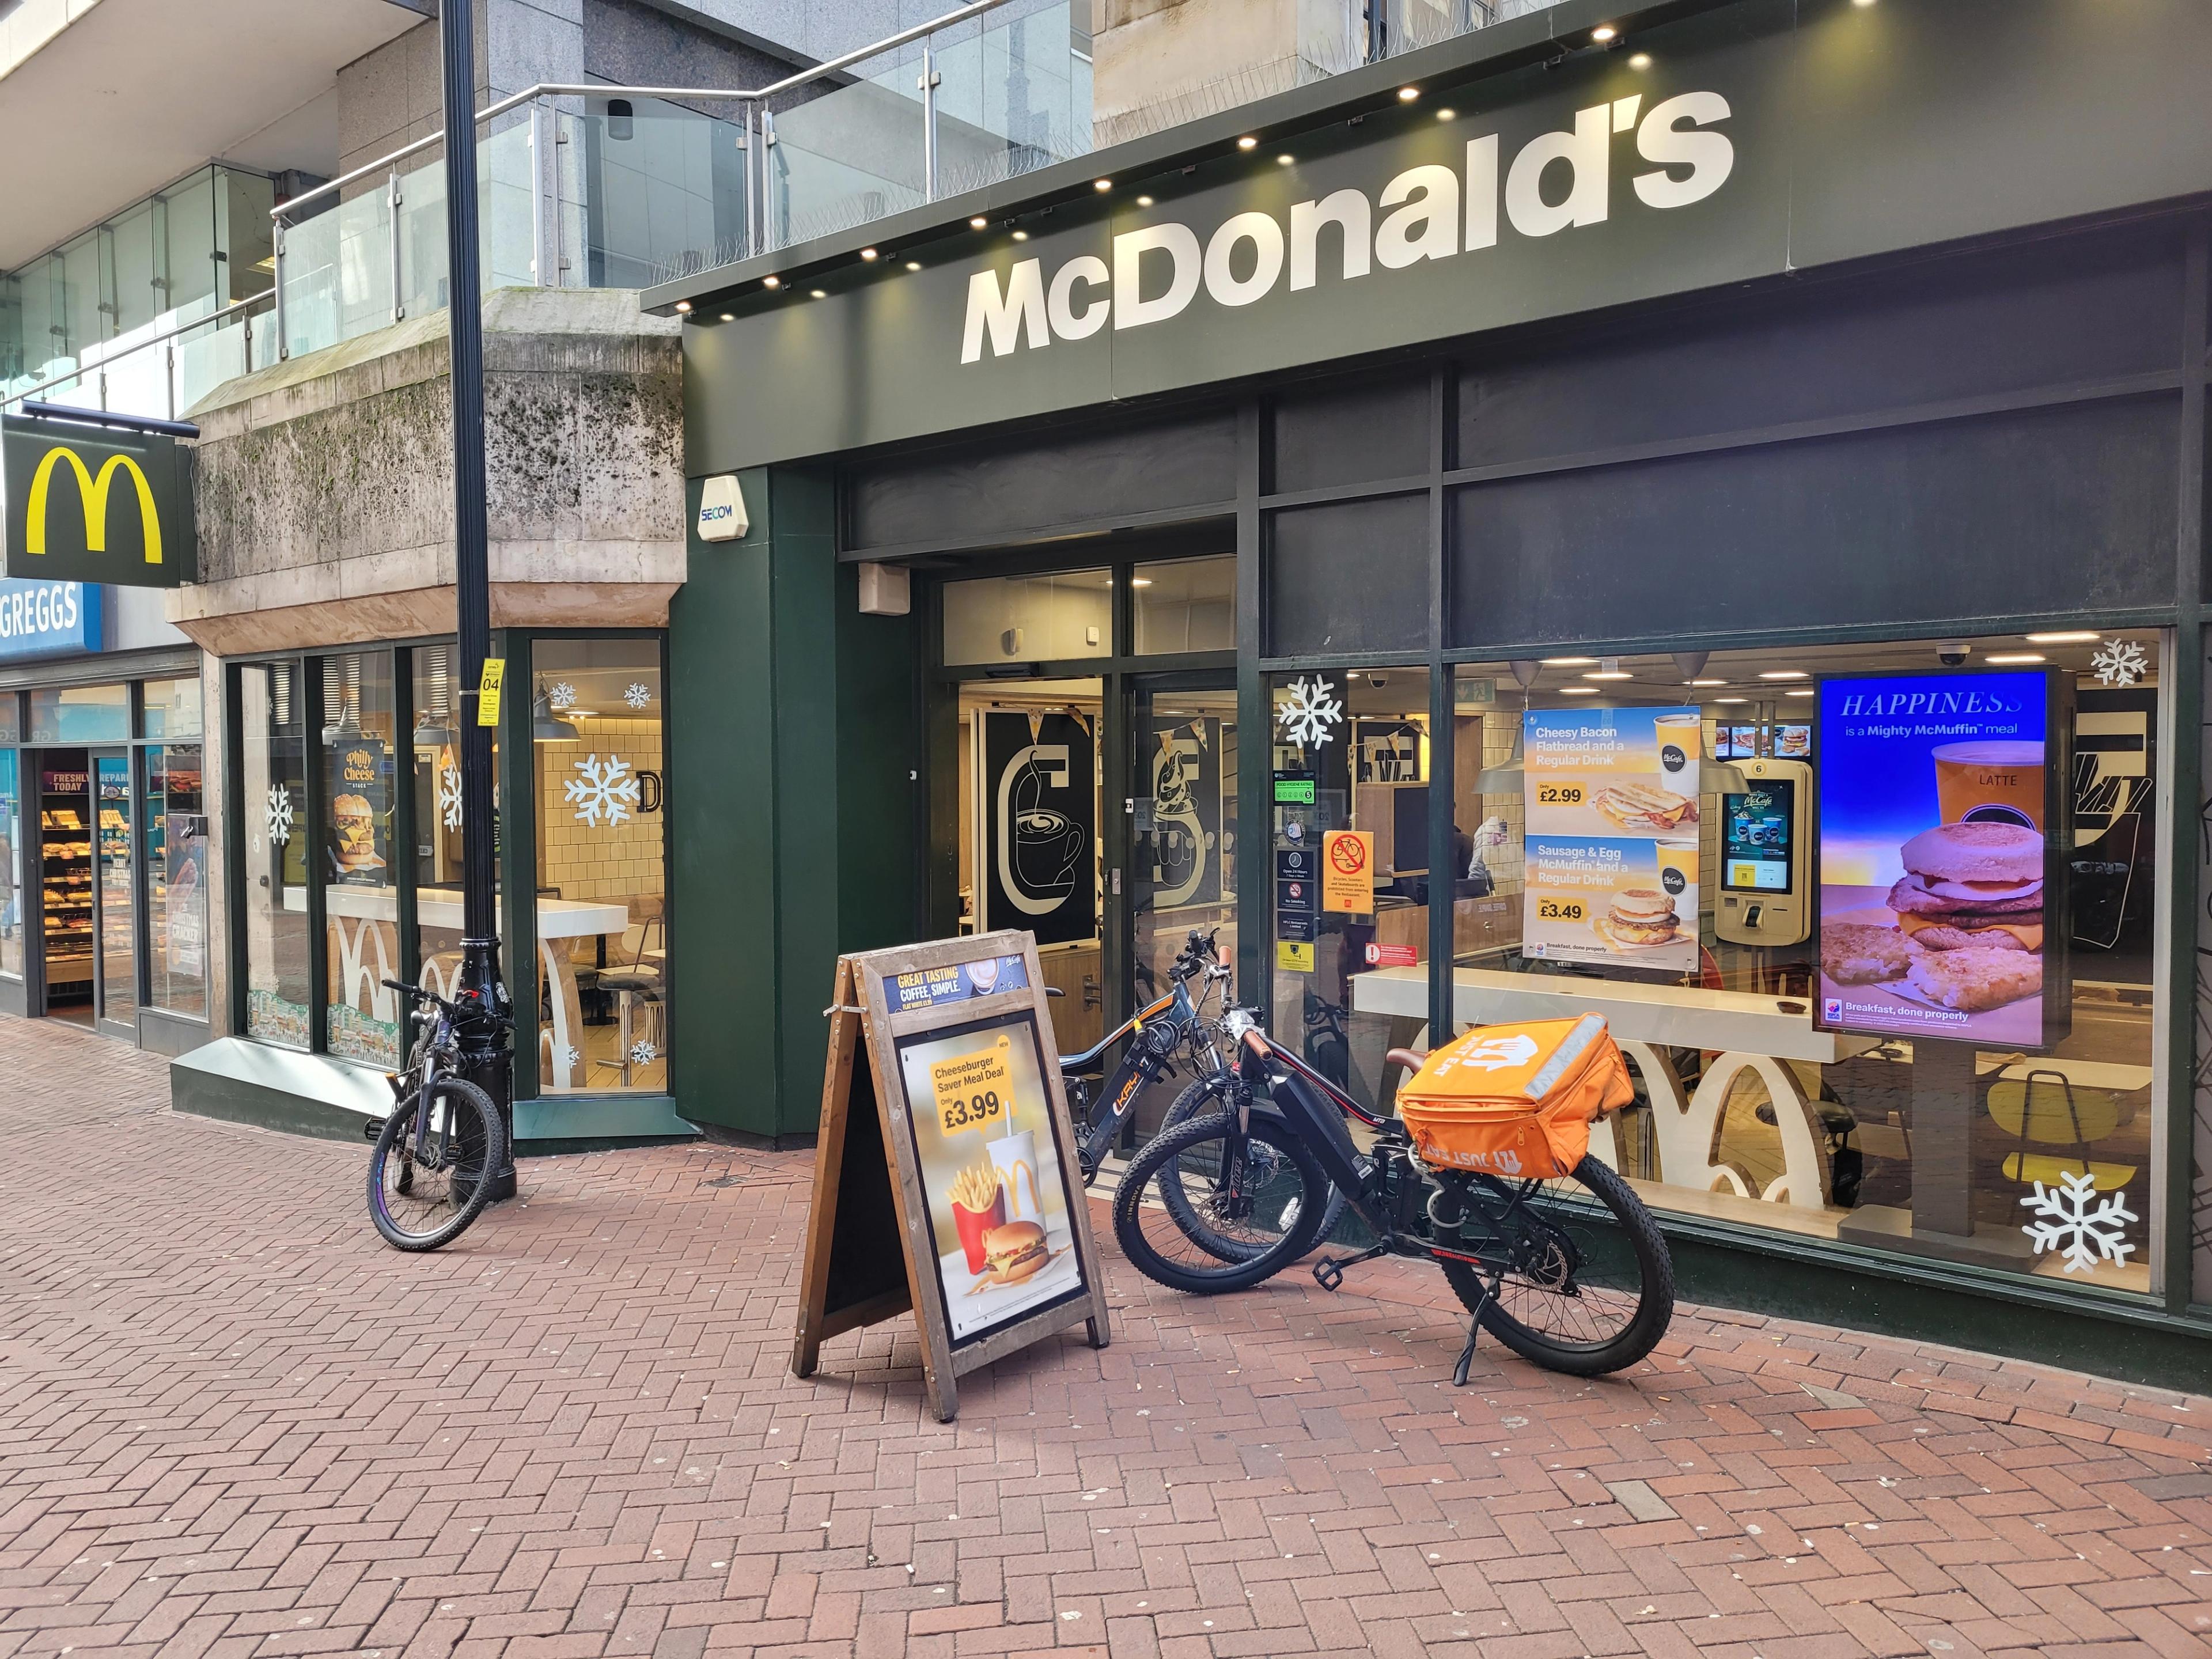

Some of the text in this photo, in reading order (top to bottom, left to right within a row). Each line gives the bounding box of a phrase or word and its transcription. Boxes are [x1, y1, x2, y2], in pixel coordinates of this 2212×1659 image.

[960, 90, 1734, 365] McDonald's
[701, 504, 732, 521] SECOM
[1, 582, 78, 637] GREGGS
[483, 678, 499, 691] 04
[1840, 691, 2023, 717] HAPPINESS
[1536, 726, 1617, 740] Cheesy Bacon
[1846, 726, 1855, 737] is
[1858, 728, 1865, 736] a
[1867, 725, 1912, 738] Mighty
[1986, 723, 2018, 734] meal
[1536, 740, 1624, 752] Flatbread and a
[346, 749, 373, 770] Philly
[1536, 755, 1614, 768] Regular Drink
[53, 774, 90, 782] FRESHLY
[344, 767, 375, 781] Cheese
[1979, 774, 2017, 786] LATTE
[53, 782, 82, 791] TODAY
[1540, 789, 1581, 802] £2.99
[1538, 844, 1622, 861] Sausage & Egg
[1597, 862, 1619, 873] and
[1621, 864, 1628, 873] a
[1538, 872, 1614, 886] Regular Drink
[1540, 904, 1582, 919] £3.49
[1546, 942, 1572, 950] Breakfast,
[897, 966, 959, 988] GREAT TASTING
[900, 985, 931, 1002] COFFEE,
[931, 980, 961, 996] SIMPLE.
[1845, 1002, 1896, 1016] Breakfast,
[1897, 1007, 1923, 1017] done
[1925, 1011, 1969, 1023] properly
[1455, 1035, 1486, 1056] JUST
[935, 1058, 994, 1079] Cheeseburger
[1433, 1057, 1460, 1077] EAT
[938, 1066, 1004, 1093] Saver Meal Deal
[941, 1097, 953, 1105] Only
[945, 1091, 999, 1129] £3.99
[1426, 1143, 1491, 1168] JUST EAT
[1127, 1185, 1142, 1215] INNOVA
